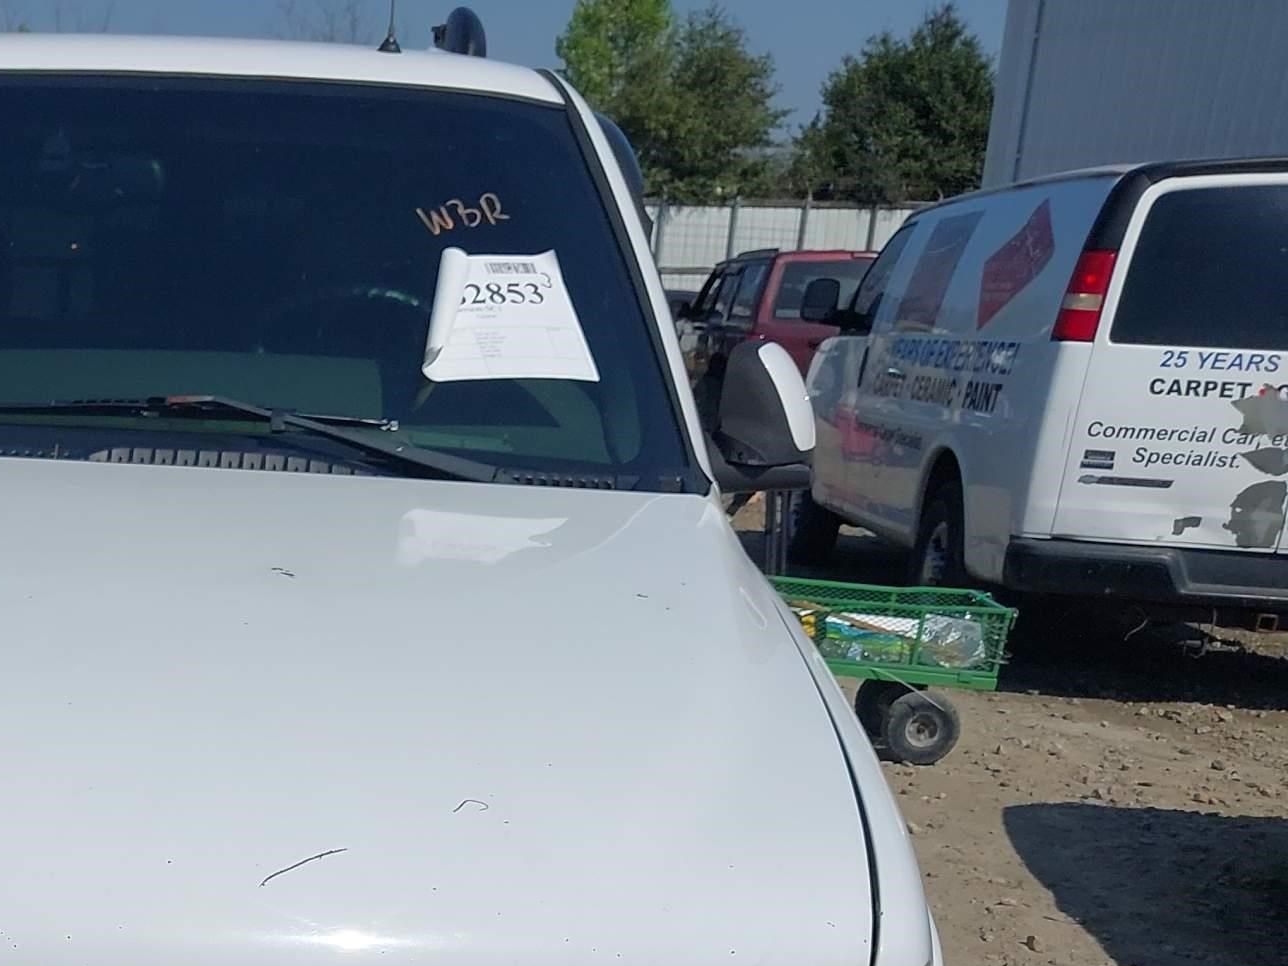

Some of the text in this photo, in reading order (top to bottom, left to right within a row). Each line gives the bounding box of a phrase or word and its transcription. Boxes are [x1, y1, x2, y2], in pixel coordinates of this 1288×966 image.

[461, 283, 544, 304] 2853
[1160, 350, 1282, 372] 25 YEARS
[962, 382, 1004, 413] PAINT
[1149, 378, 1253, 399] CARPET
[1087, 421, 1217, 443] Commercial
[1132, 447, 1241, 468] Specialist.
